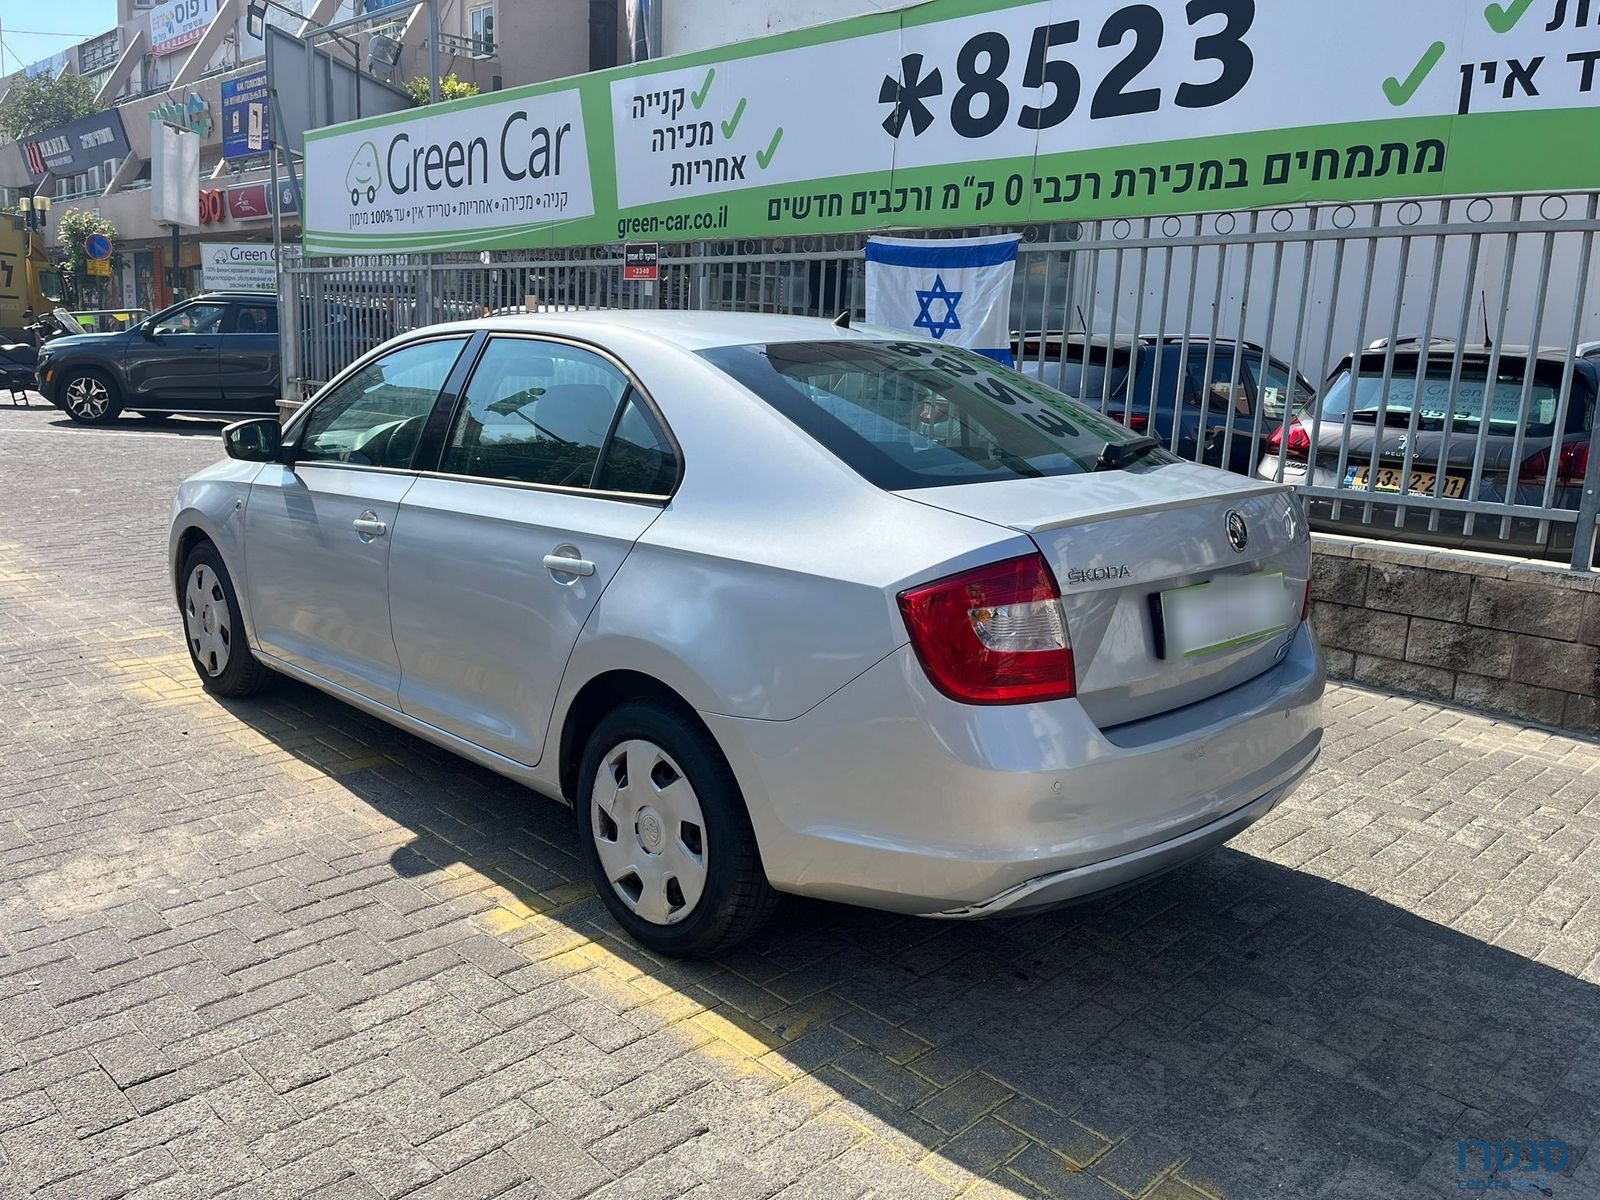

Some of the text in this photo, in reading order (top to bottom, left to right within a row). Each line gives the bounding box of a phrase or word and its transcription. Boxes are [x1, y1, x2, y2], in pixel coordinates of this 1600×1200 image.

[1457, 55, 1546, 115] אין
[632, 87, 686, 121] קנייה
[386, 109, 571, 196] Green Car
[652, 120, 714, 153] מכירה
[669, 154, 747, 187] אחריות
[1110, 157, 1249, 199] במכירת
[1263, 138, 1446, 186] מתמחים
[850, 186, 934, 216] ורכבים
[1005, 173, 1024, 206] 0
[1032, 172, 1101, 205] רכבי
[348, 191, 568, 230] קניה מכירה אחריות טרייד אין עד 100% מימון
[617, 205, 728, 239] green-car.co.il
[767, 193, 843, 221] חדשים
[229, 246, 268, 261] Green
